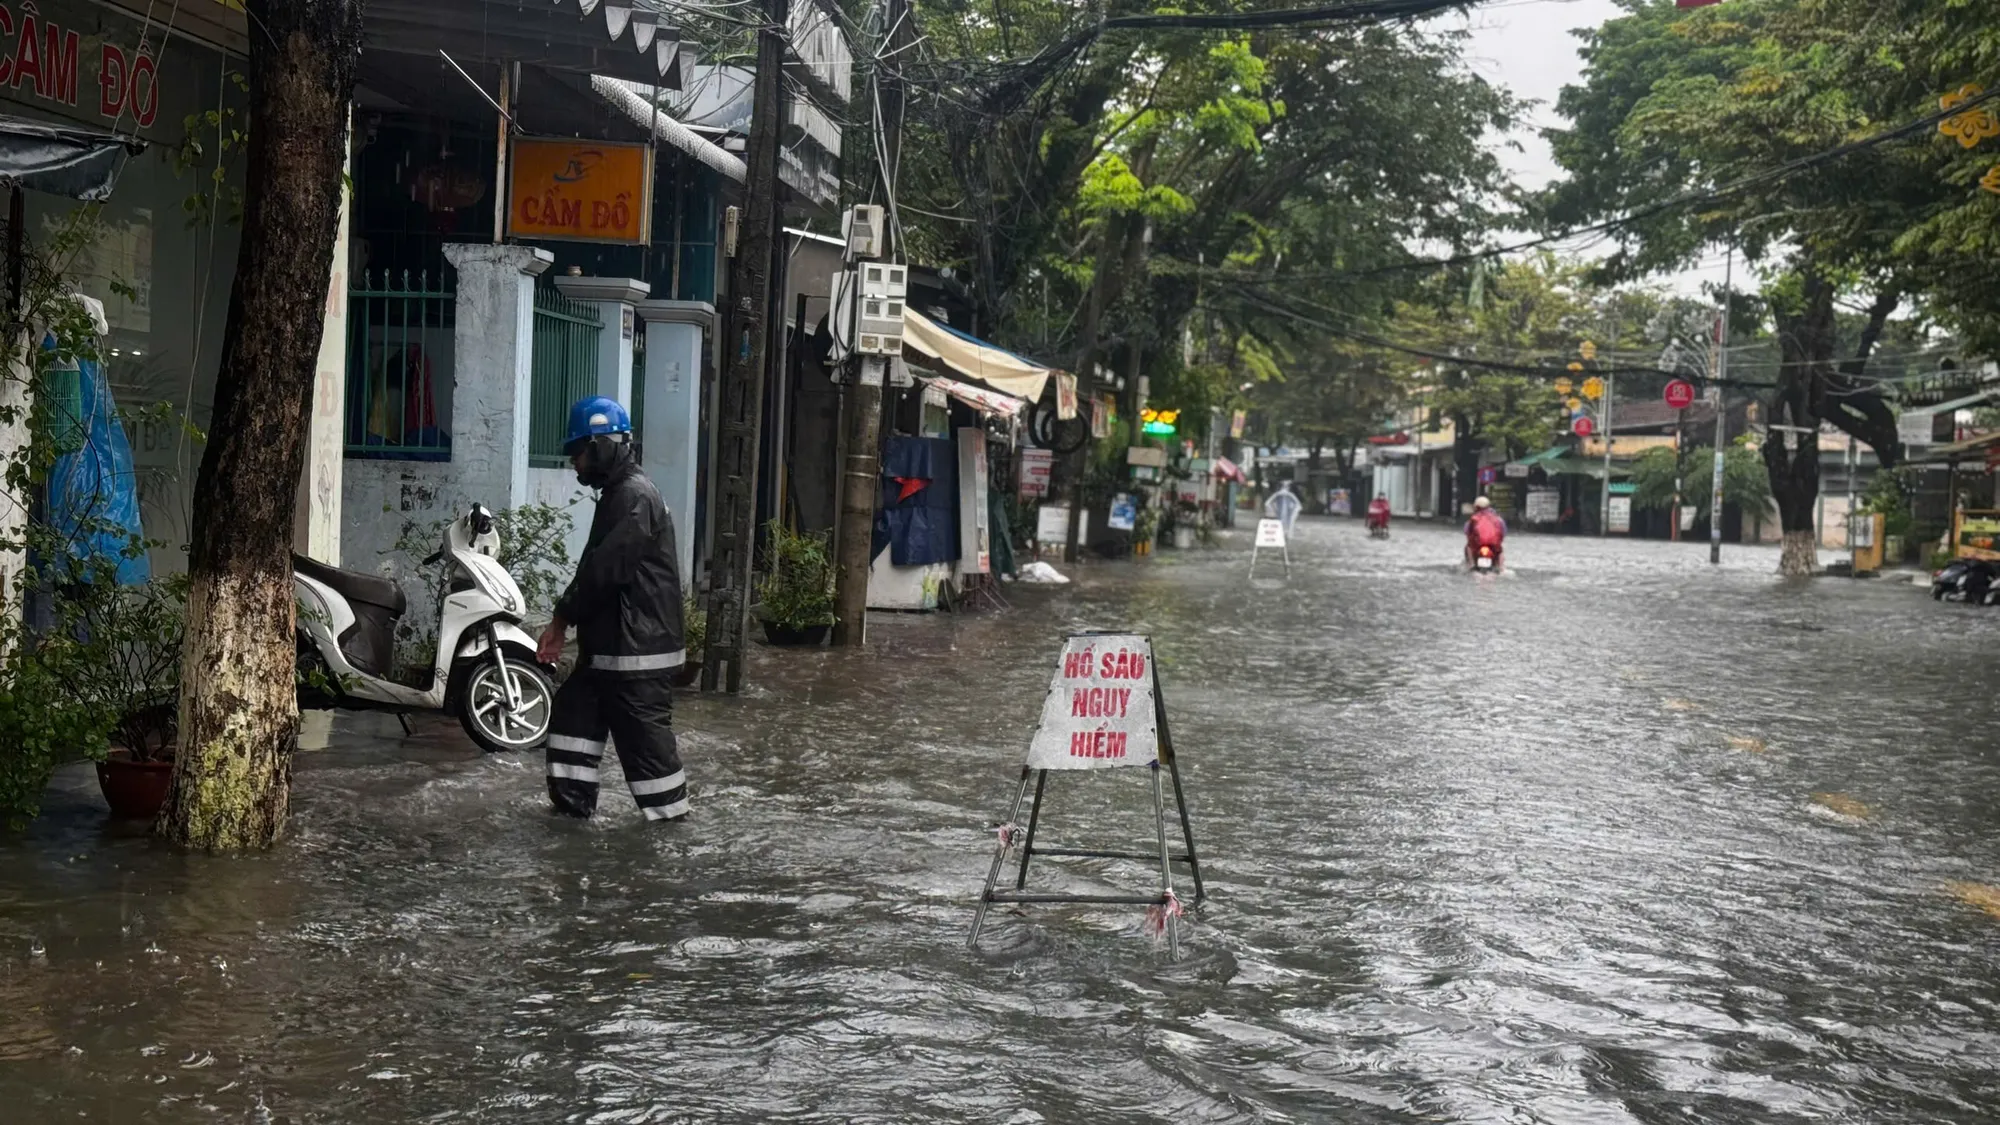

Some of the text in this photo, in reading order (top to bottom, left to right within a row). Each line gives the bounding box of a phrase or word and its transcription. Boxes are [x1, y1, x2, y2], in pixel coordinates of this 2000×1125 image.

[520, 184, 632, 230] CẦM ĐỒ
[1064, 643, 1145, 679] HỐ SÂU
[1071, 687, 1131, 718] NGUY
[1070, 721, 1127, 758] HIỂM
